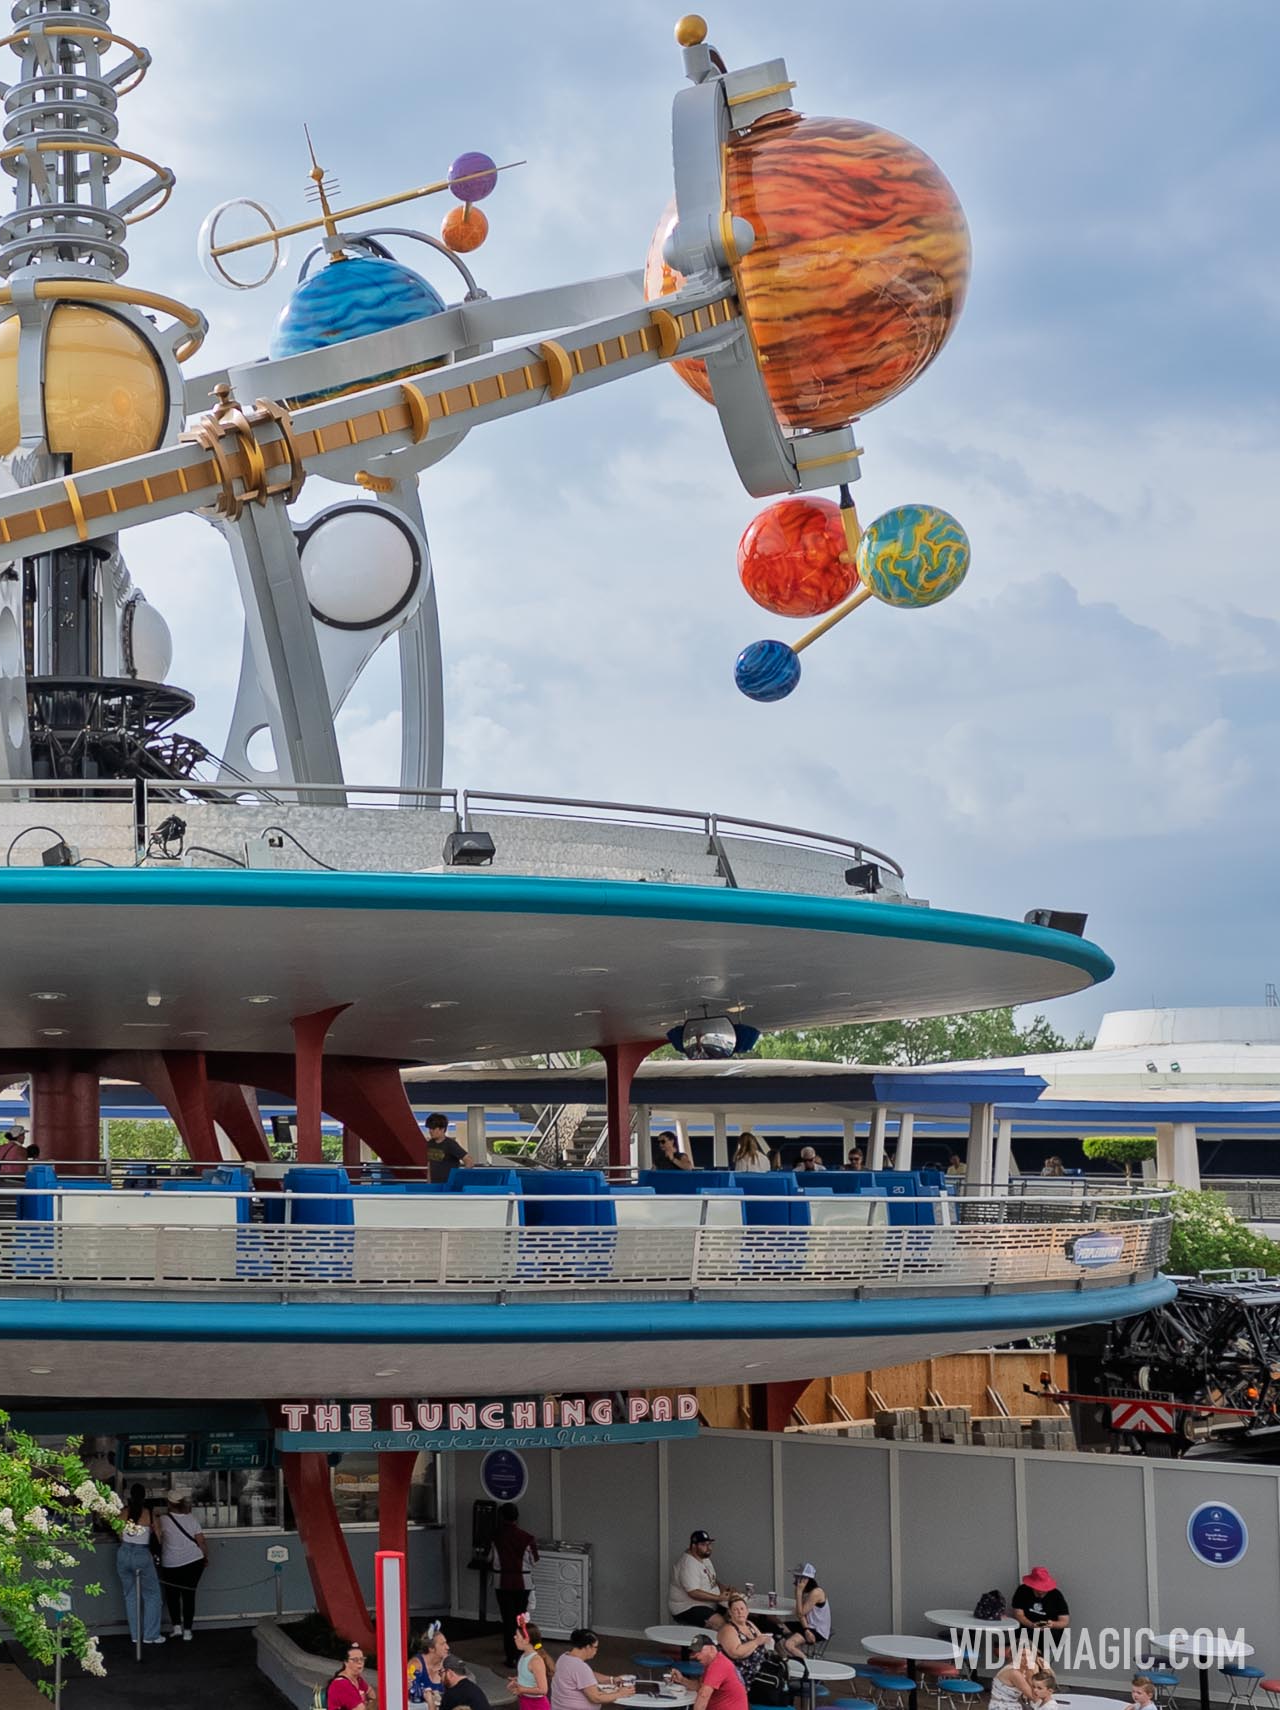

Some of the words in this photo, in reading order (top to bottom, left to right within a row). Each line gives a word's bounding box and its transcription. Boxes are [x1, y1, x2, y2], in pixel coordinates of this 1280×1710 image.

[281, 1403, 373, 1433] THE
[392, 1398, 613, 1432] LUNCHING
[628, 1393, 699, 1423] PAD
[556, 1429, 612, 1444] Plaza
